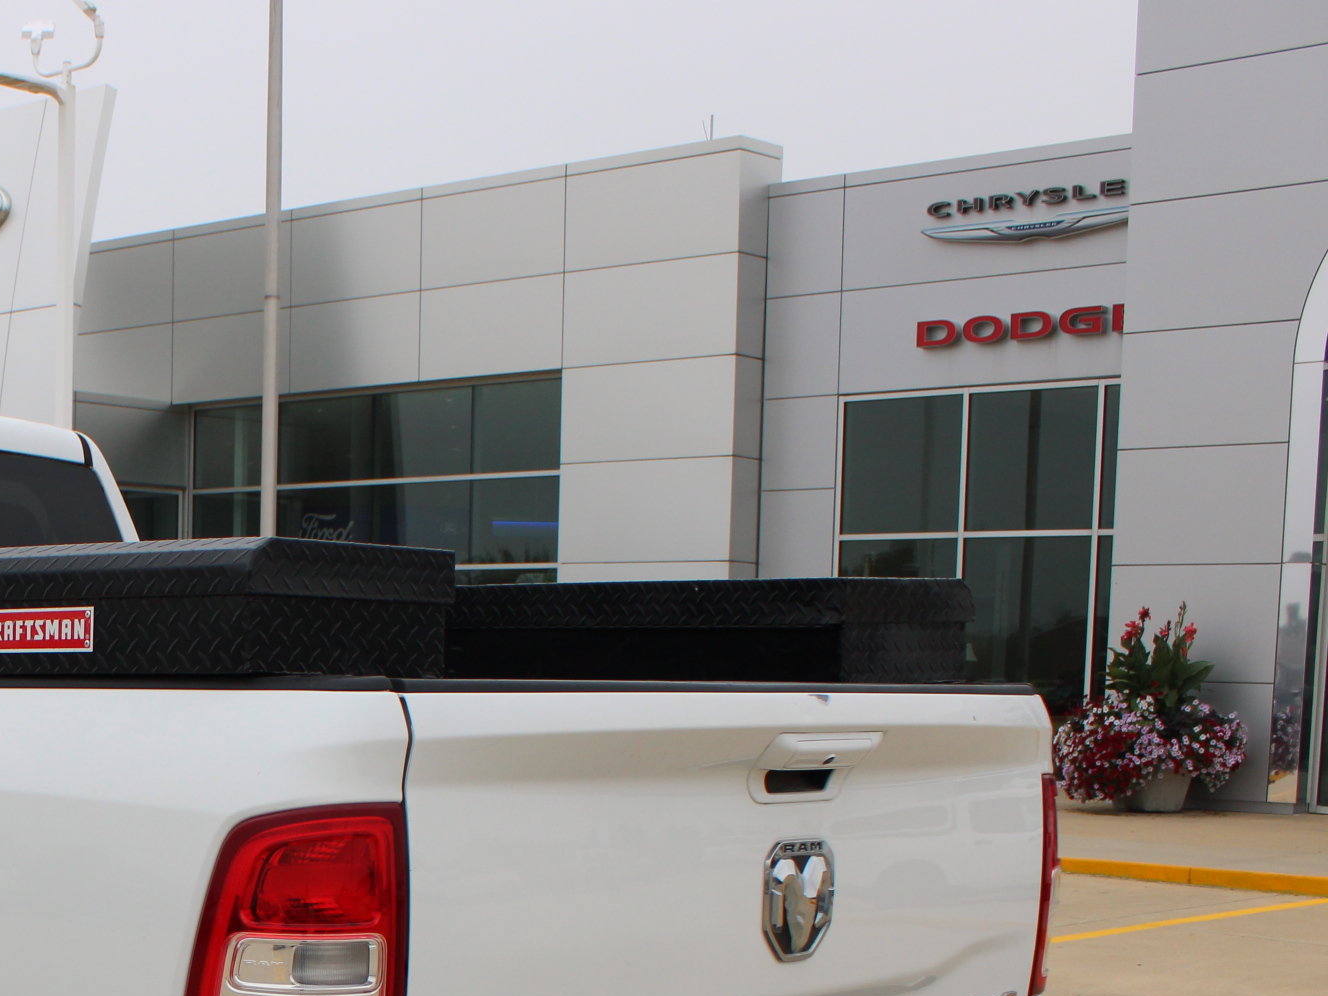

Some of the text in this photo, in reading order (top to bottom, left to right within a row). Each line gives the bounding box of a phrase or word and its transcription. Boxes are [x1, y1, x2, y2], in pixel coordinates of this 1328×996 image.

[916, 303, 1125, 348] DODG
[299, 512, 355, 542] Ford
[782, 841, 824, 853] RAM
